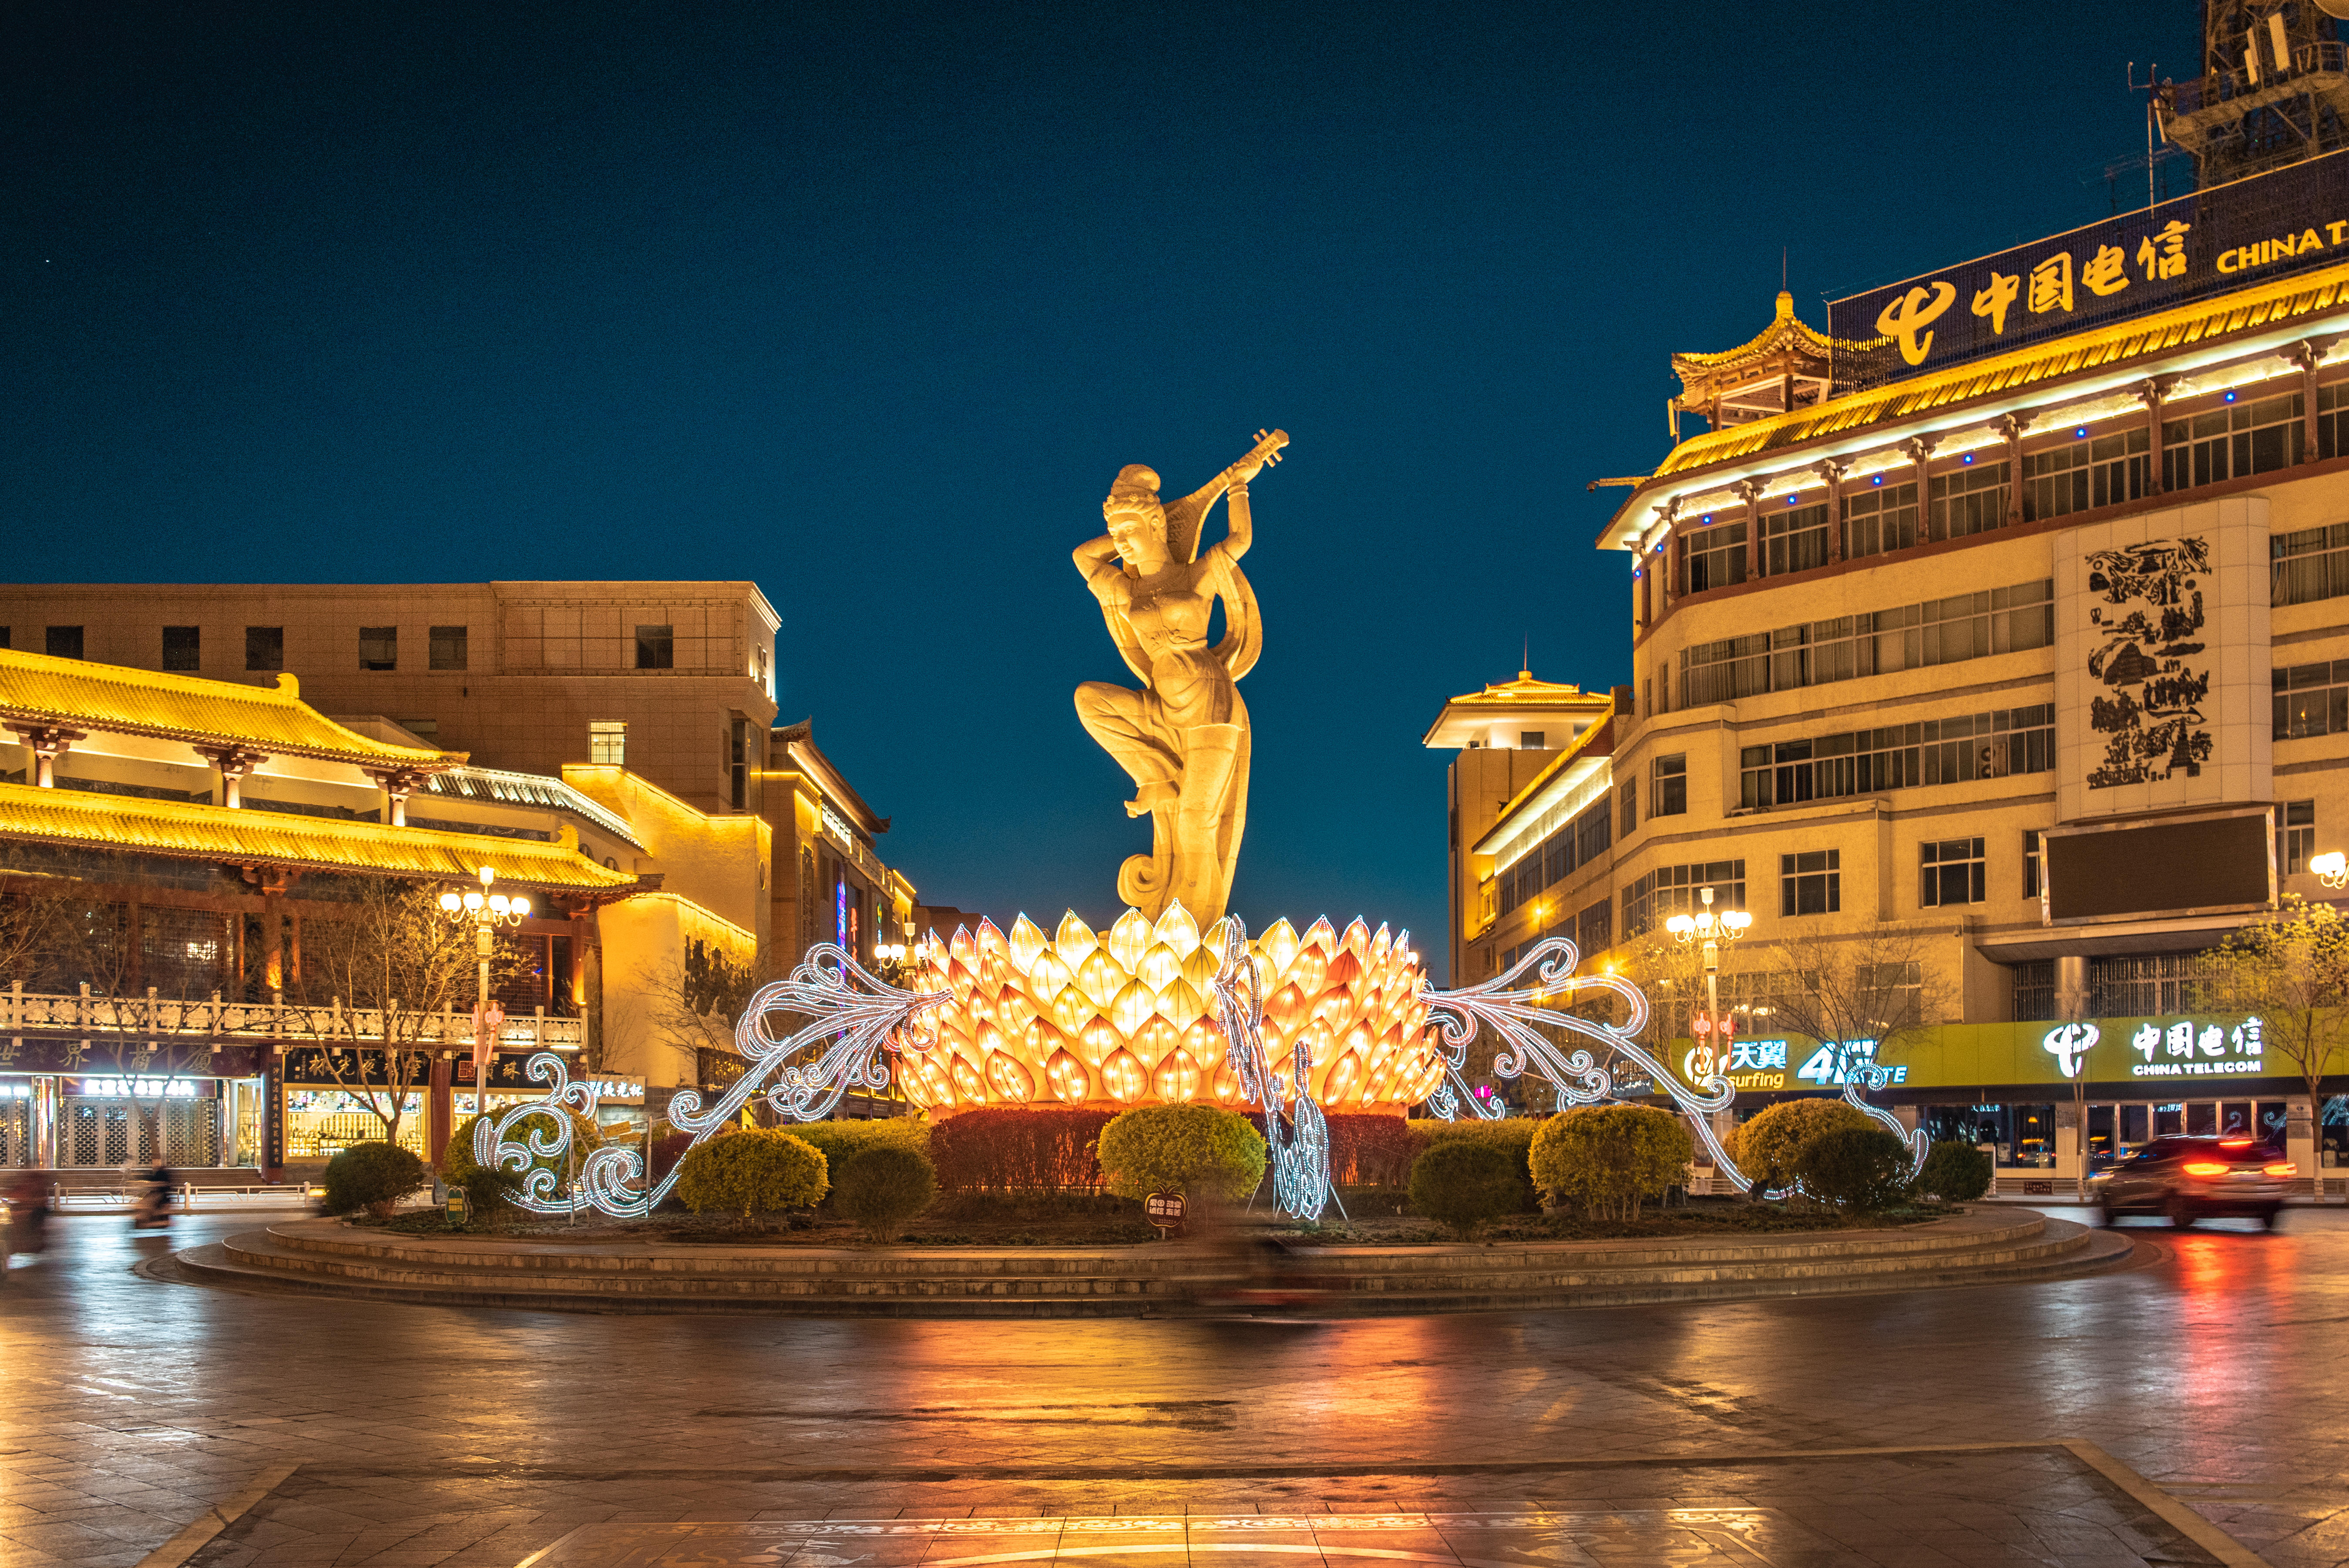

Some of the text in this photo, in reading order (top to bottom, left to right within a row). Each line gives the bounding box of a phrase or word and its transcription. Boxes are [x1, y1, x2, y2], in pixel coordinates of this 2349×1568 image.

[2217, 219, 2349, 274] CHINA T
[1972, 219, 2191, 335] 中国电信
[1731, 1040, 1787, 1071] 天翼
[2133, 1017, 2263, 1062] 中国电信
[2133, 1060, 2262, 1076] CHINA TELECOM
